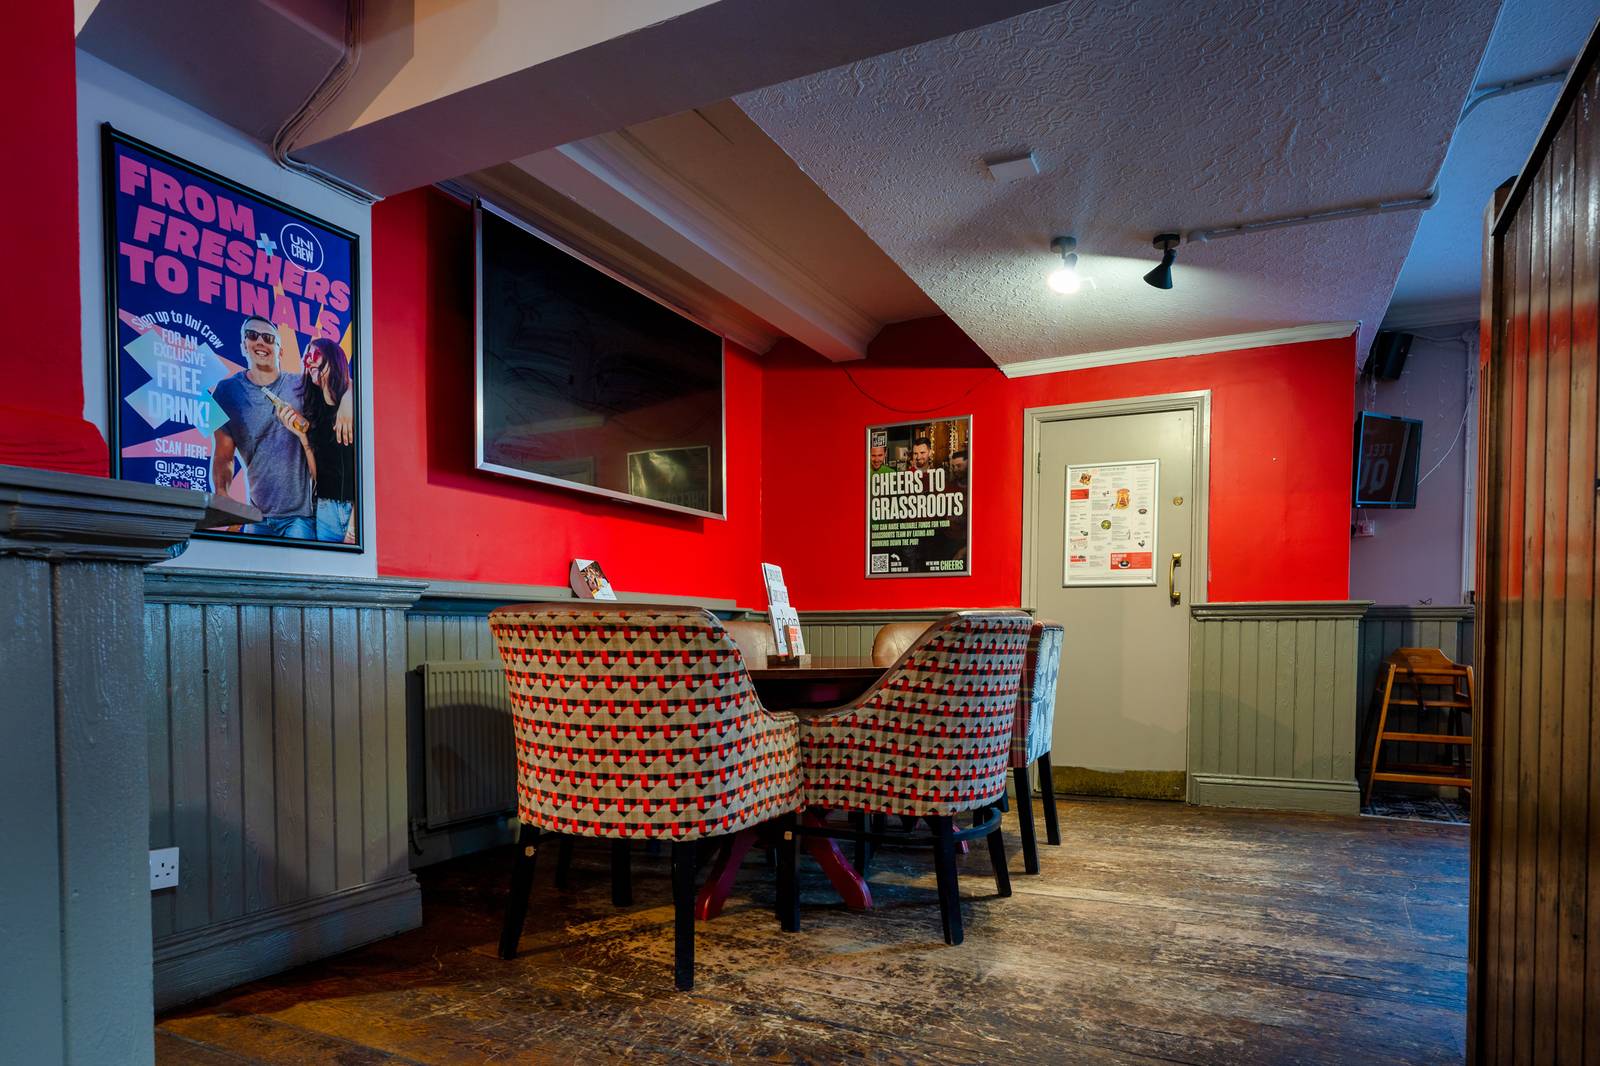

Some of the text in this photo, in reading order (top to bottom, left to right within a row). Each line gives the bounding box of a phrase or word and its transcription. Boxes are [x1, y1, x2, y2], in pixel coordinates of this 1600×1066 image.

[119, 154, 256, 240] FROM
[290, 233, 314, 251] UNI
[291, 243, 314, 263] CREW
[133, 205, 350, 312] FRESHERS
[119, 241, 341, 343] TO FINALS
[131, 310, 224, 349] Sign up to Uni Crew
[162, 328, 198, 350] FOR AN
[153, 341, 207, 367] EXCLUSIVE
[157, 361, 202, 396] FREE
[148, 391, 210, 428] DRINK!
[155, 438, 208, 460] SCAN HERE
[872, 468, 945, 497] CHEERS TO
[872, 492, 964, 521] GRASSROOTS
[940, 560, 964, 571] CHEERS
